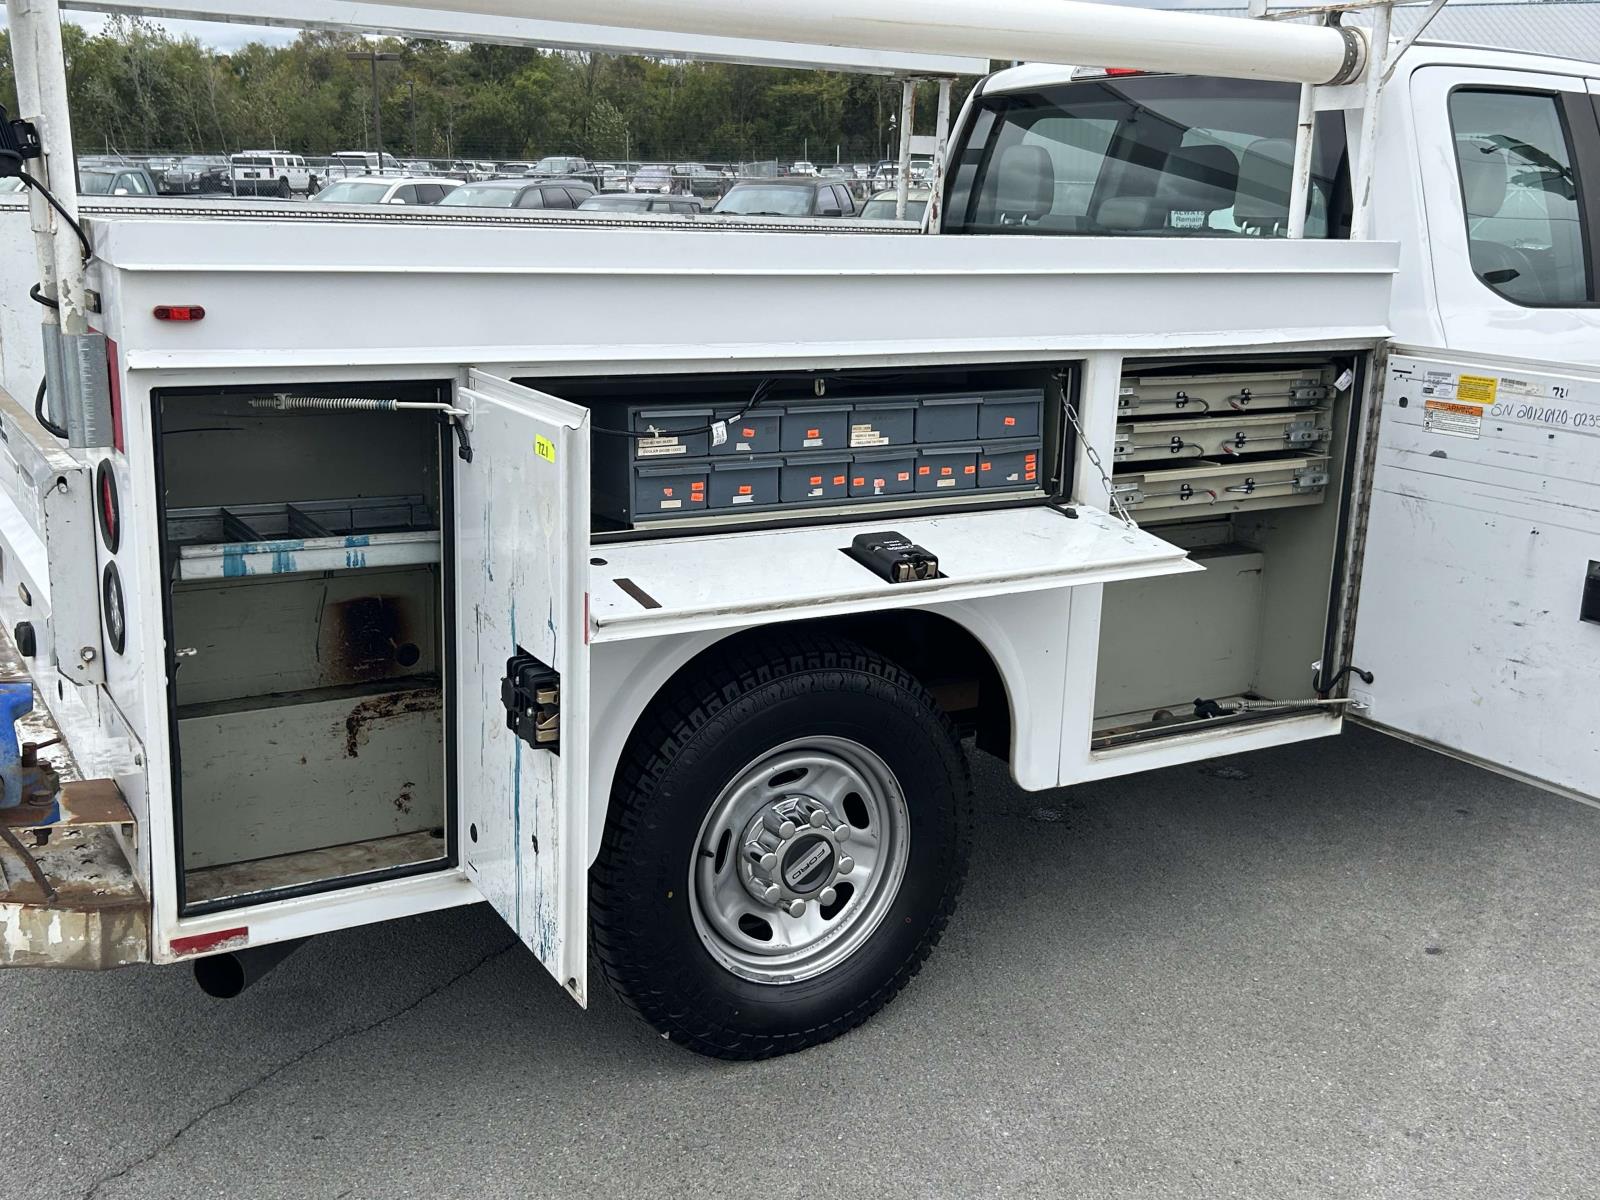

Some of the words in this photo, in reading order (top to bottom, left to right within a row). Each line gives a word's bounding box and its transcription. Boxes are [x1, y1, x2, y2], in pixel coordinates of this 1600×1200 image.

[1552, 386, 1569, 399] 721
[1490, 403, 1514, 417] SN
[537, 441, 548, 458] 721
[792, 848, 826, 880] FORD
